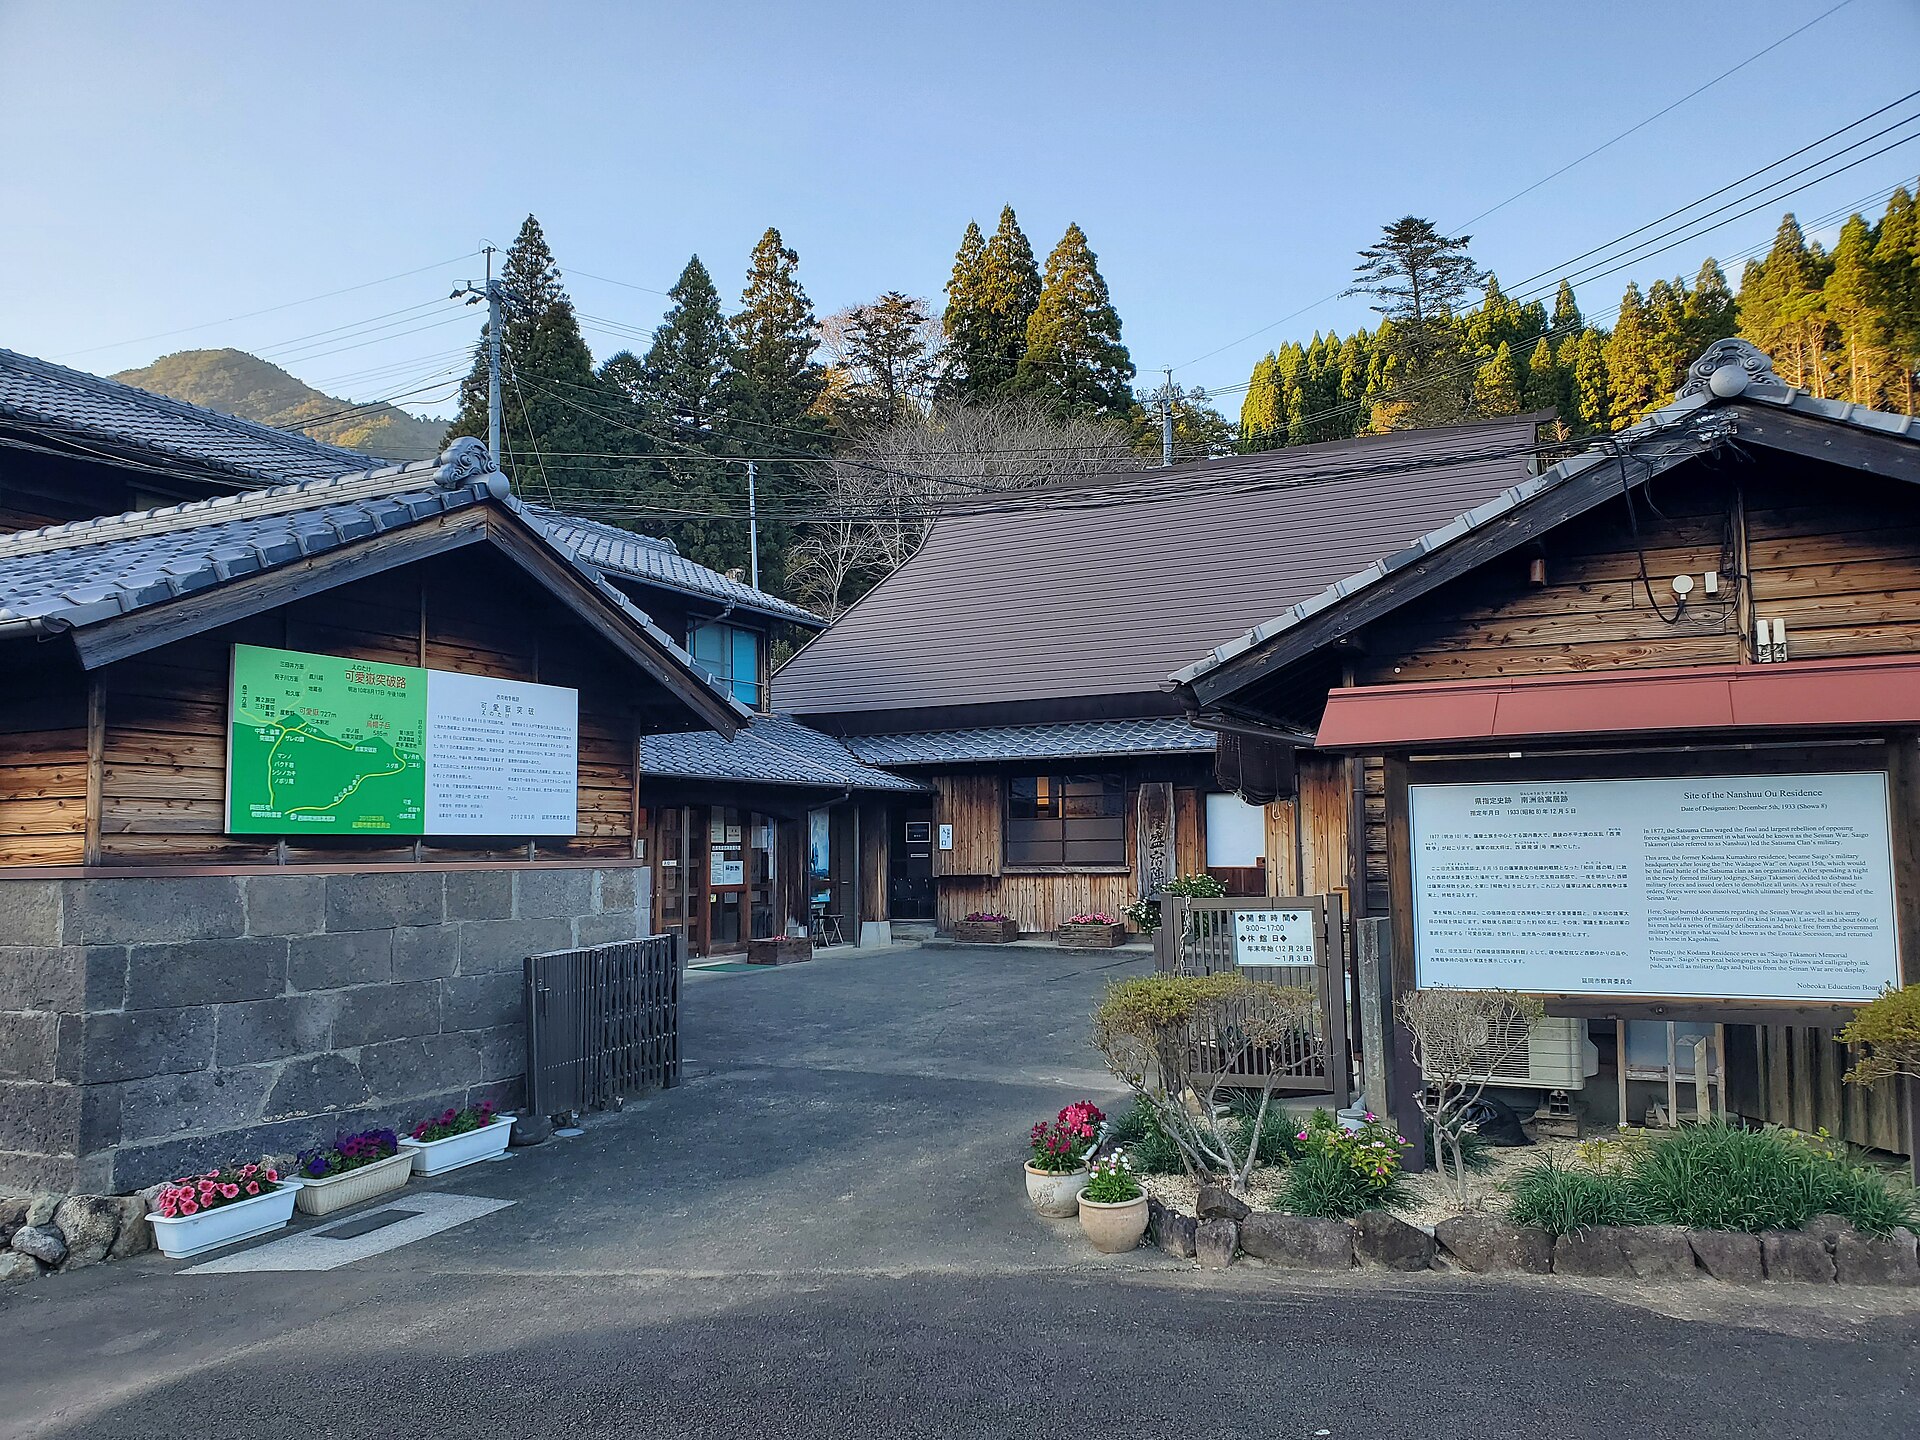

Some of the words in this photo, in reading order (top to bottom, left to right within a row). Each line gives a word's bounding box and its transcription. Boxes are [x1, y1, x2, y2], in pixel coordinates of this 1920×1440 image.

[344, 670, 406, 688] 可愛嶽突破路
[1684, 791, 1700, 799] Site
[1702, 790, 1710, 799] of
[1712, 790, 1724, 799] the
[1727, 790, 1762, 799] Nanshuu
[1765, 789, 1777, 798] Ou
[1780, 788, 1822, 798] Residence
[1474, 797, 1512, 805] 県指定史跡
[1520, 796, 1568, 804] 南洲翁寓居跡
[1248, 934, 1278, 942] 休館日
